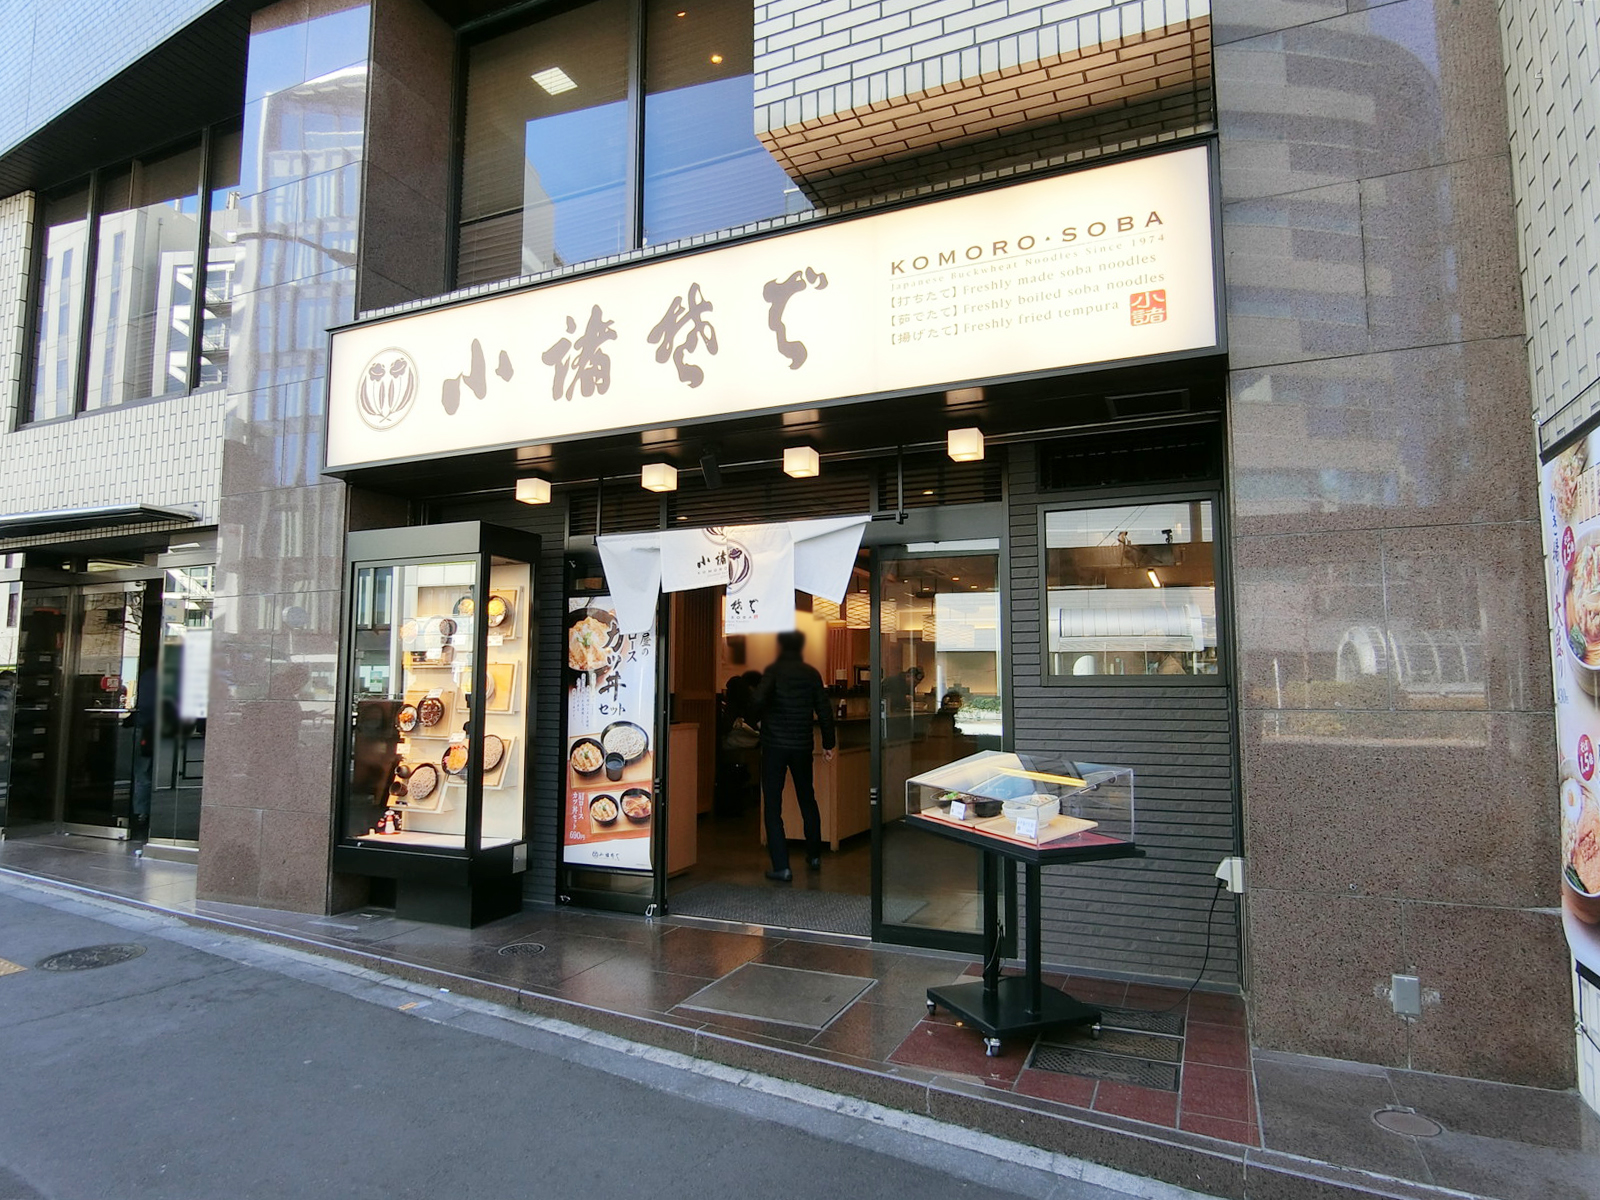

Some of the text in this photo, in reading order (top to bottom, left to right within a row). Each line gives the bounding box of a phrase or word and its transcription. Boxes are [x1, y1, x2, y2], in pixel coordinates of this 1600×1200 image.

[890, 210, 1164, 276] KOMORO SOBA
[891, 233, 1165, 292] Japanese Buckwheat Noodles Since 1974
[963, 278, 1012, 295] Freshly
[1017, 270, 1055, 287] made
[1060, 265, 1092, 279] soba
[1098, 252, 1157, 272] noodles
[963, 297, 1012, 315] Freshly
[1017, 288, 1062, 306] boiled
[1068, 283, 1100, 298] soba
[1106, 271, 1166, 291] noodles
[963, 316, 1013, 333] Freshly
[1018, 310, 1052, 326] fried
[1058, 300, 1120, 320] tempura
[598, 622, 627, 702] カツ丼
[598, 702, 627, 717] セット
